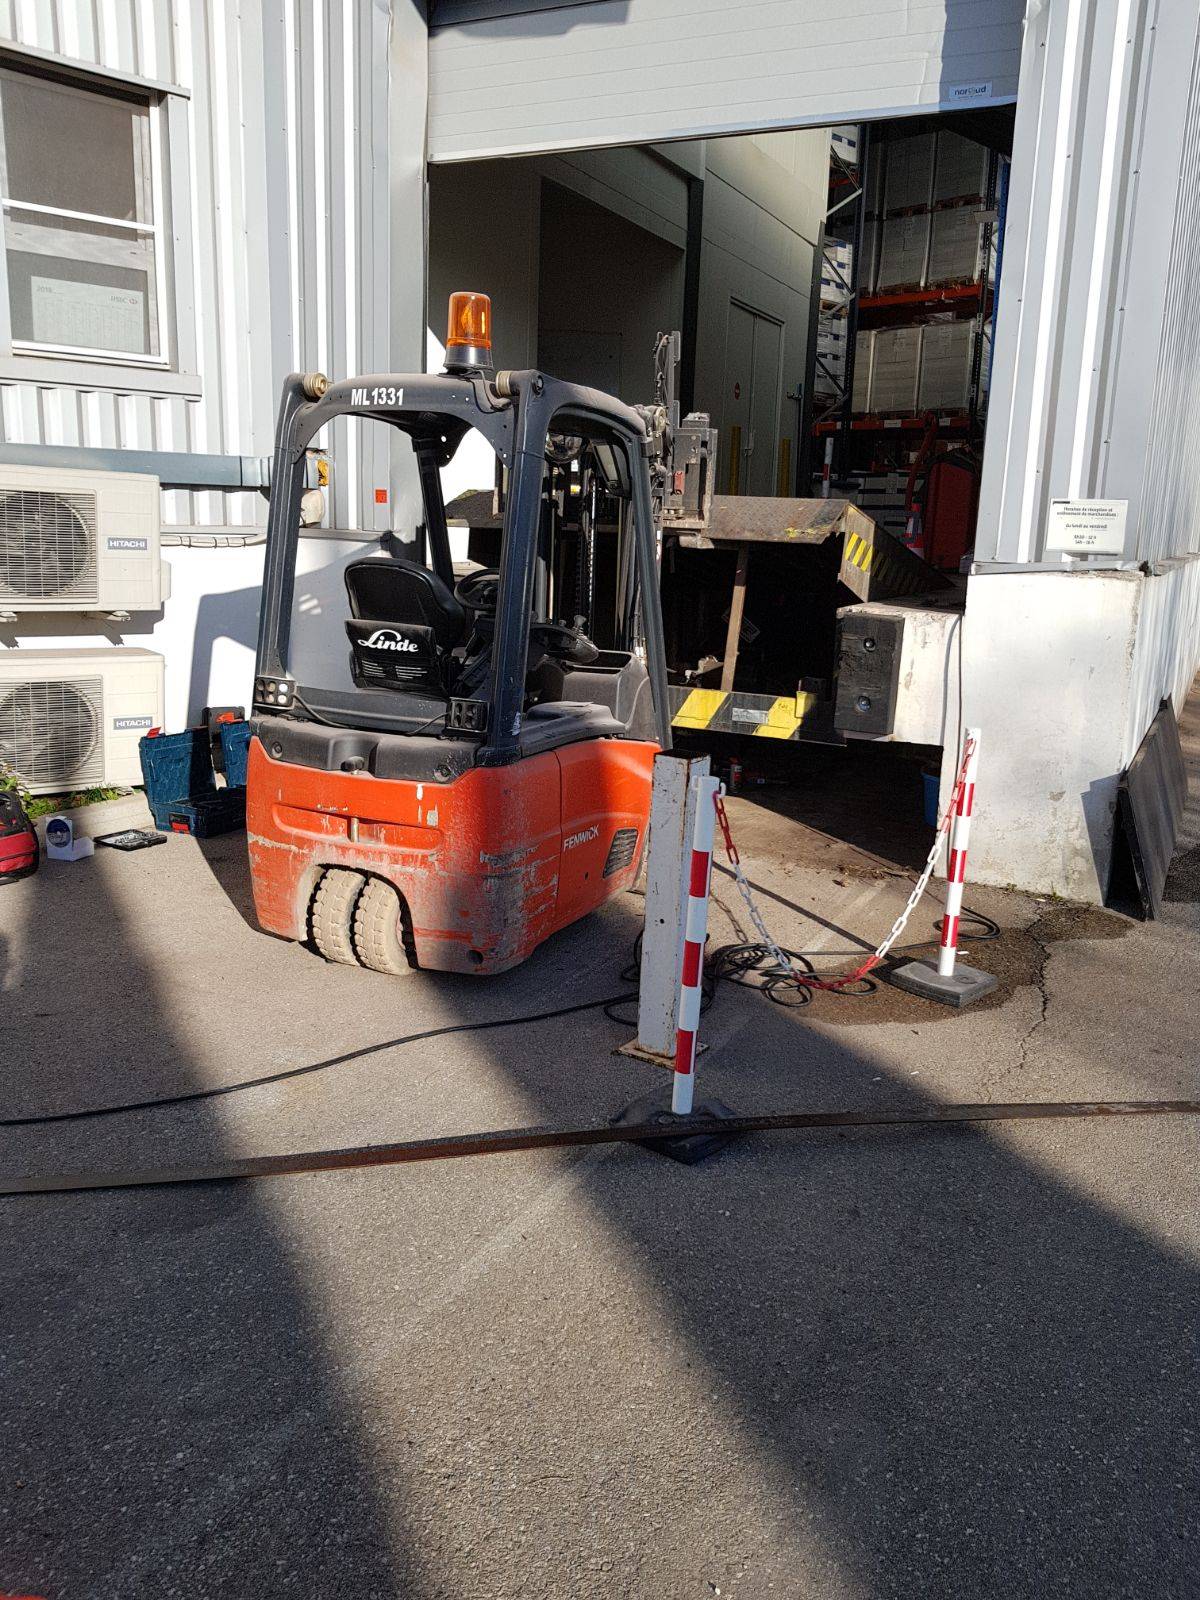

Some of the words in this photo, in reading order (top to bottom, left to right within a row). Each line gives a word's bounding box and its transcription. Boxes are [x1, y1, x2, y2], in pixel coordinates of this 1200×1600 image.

[109, 540, 145, 548] HITACHI
[357, 629, 419, 653] Linde
[116, 719, 151, 728] HITACHI
[563, 824, 600, 853] FENWICK
